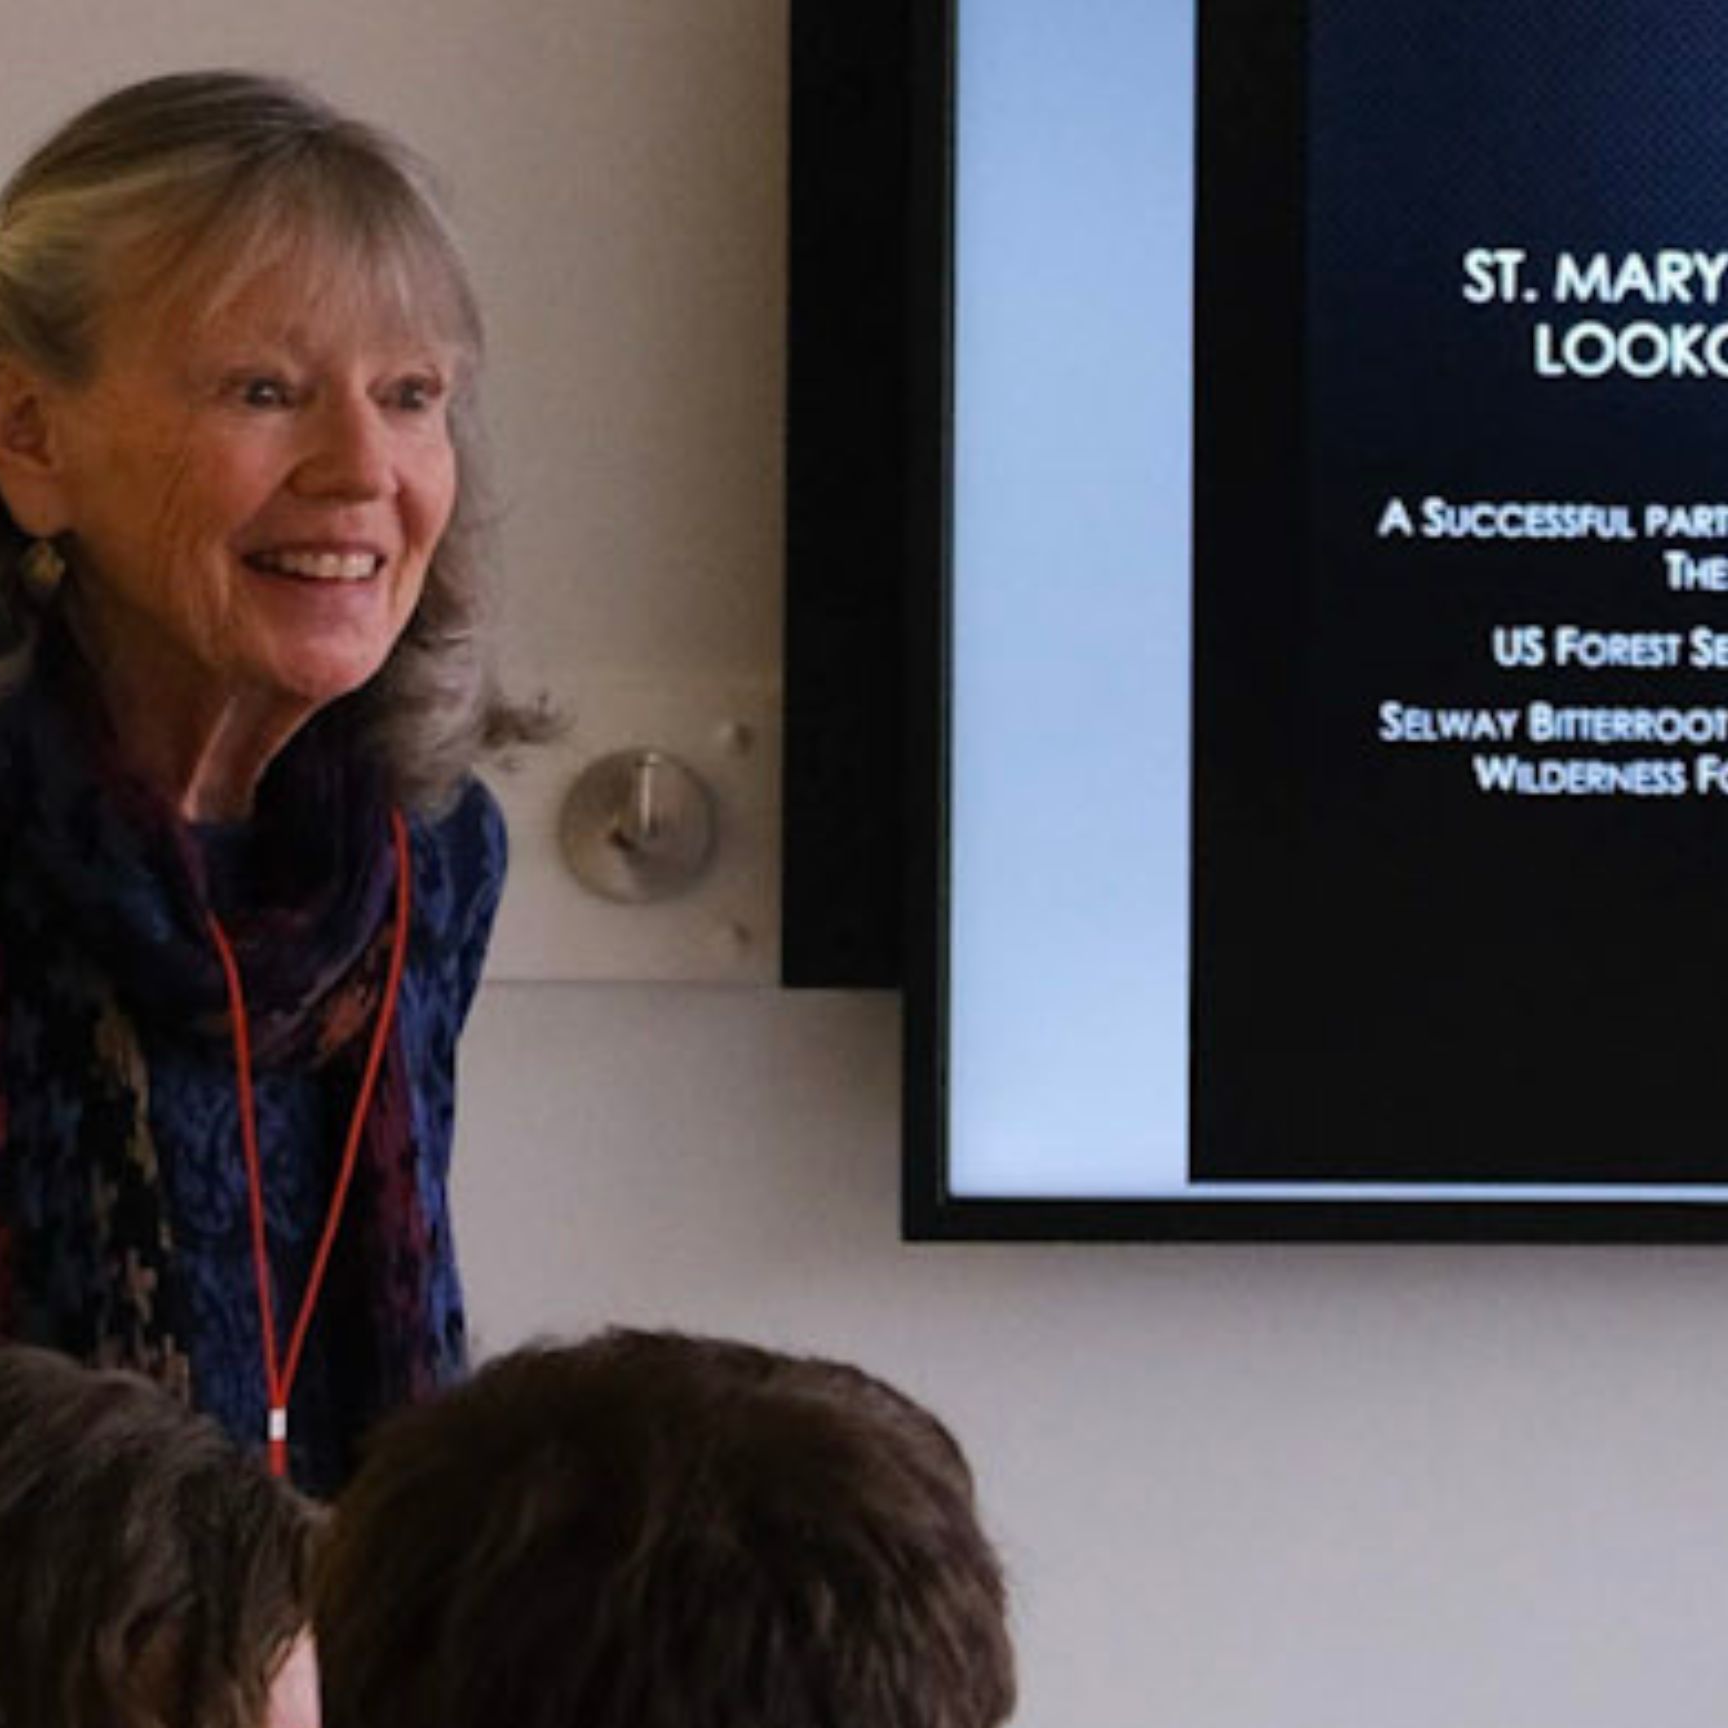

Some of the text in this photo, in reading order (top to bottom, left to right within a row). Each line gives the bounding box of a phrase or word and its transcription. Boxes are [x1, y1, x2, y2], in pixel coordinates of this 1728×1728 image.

[1462, 247, 1540, 304] ST.
[1378, 498, 1414, 537] A
[1493, 625, 1546, 667] US
